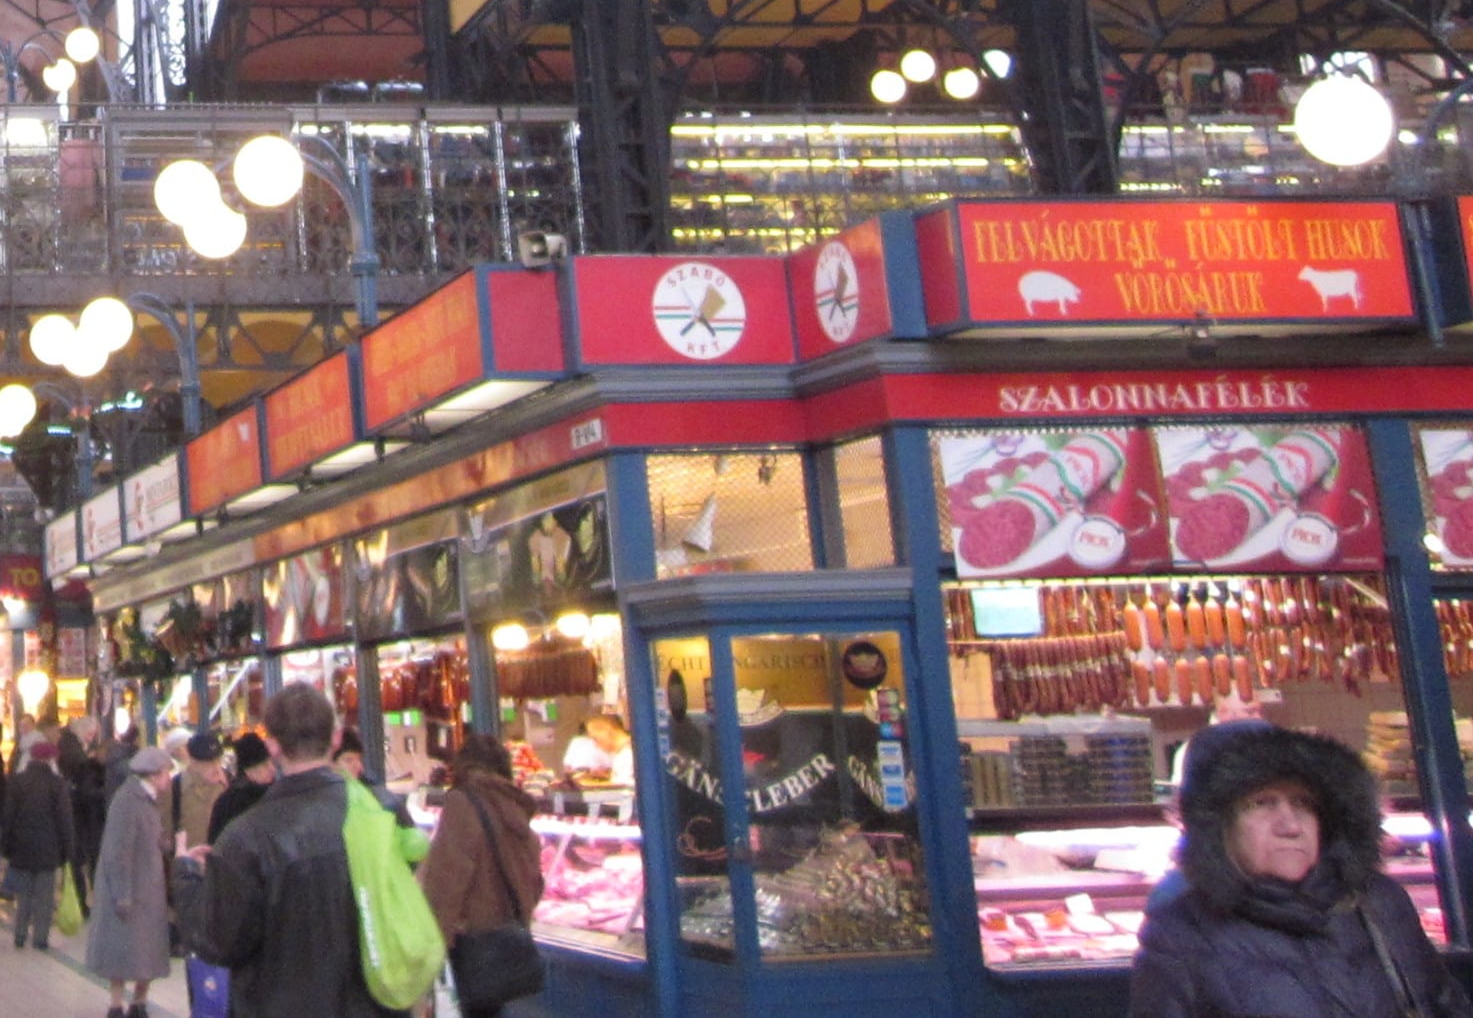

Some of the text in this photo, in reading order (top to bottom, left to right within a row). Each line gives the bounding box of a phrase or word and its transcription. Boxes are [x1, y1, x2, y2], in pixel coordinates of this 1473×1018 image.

[973, 205, 1391, 263] FELVÁGOTTAK FÜSTÖLT HUSOK
[1114, 257, 1267, 315] VÖRÖSÁRUK
[999, 374, 1310, 414] SZALONNAFÉLÉK
